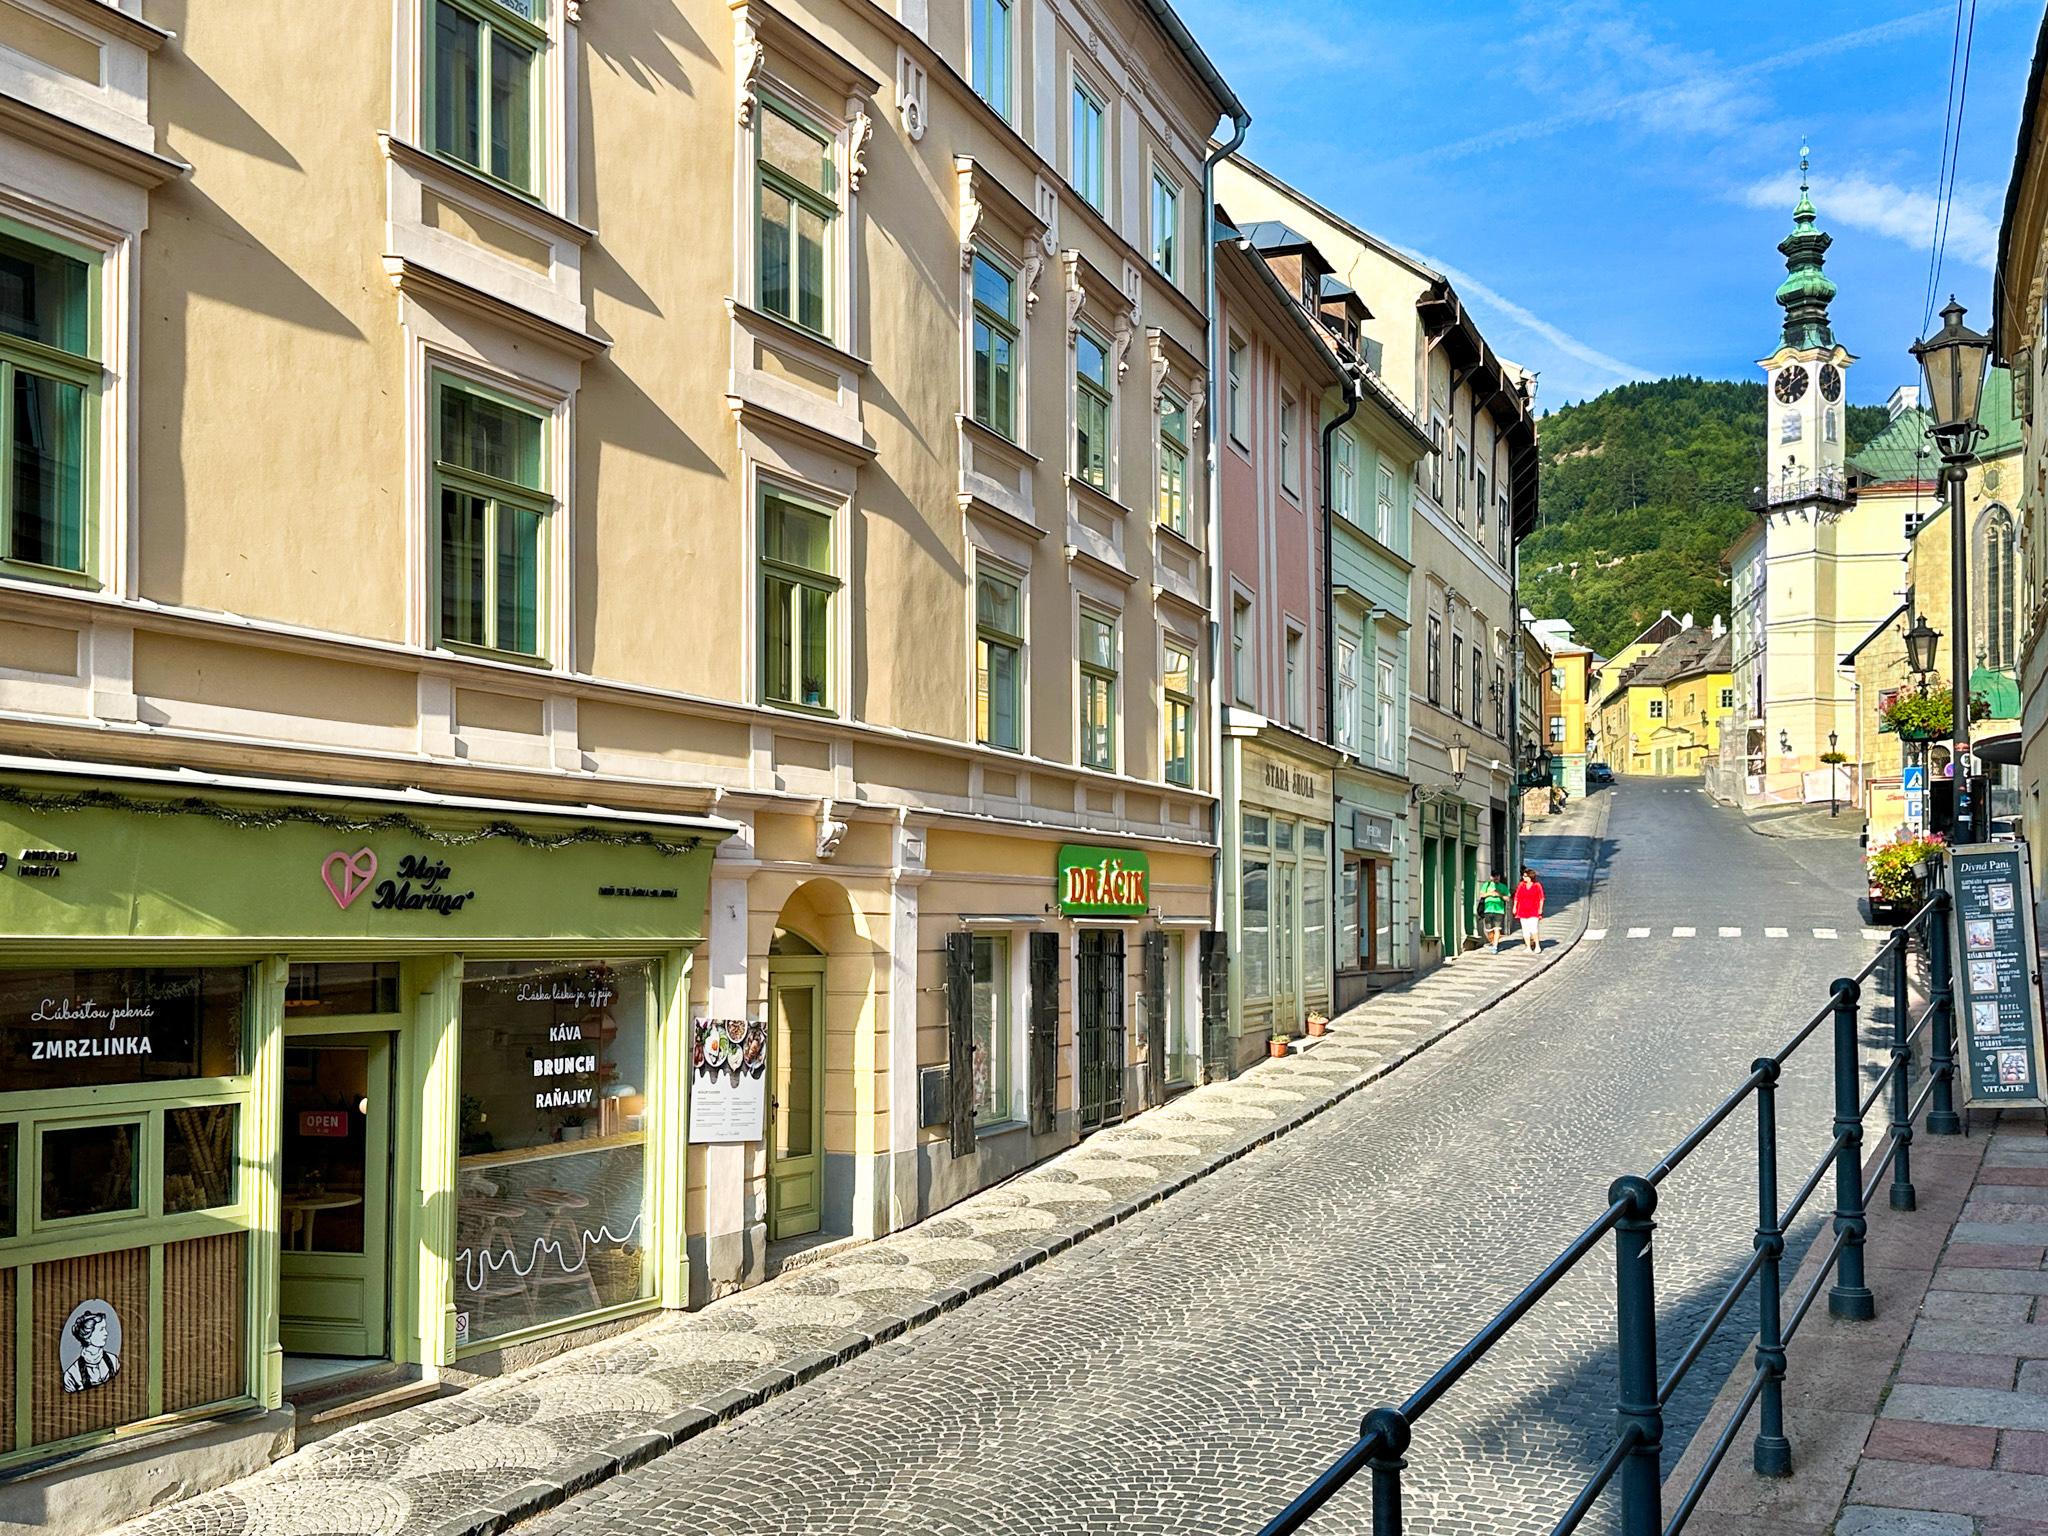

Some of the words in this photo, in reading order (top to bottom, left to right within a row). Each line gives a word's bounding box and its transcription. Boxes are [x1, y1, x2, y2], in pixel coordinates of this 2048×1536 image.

[1266, 763, 1289, 792] STARÁ
[1293, 767, 1314, 799] ŠKOLA
[397, 855, 451, 890] Moja
[1960, 861, 1988, 872] Divná
[1066, 858, 1146, 904] DRÁČIK
[372, 880, 475, 915] Marína
[109, 998, 154, 1030] pekná
[549, 1023, 581, 1042] KÁVA
[32, 1036, 152, 1060] ZMRZLINKA
[533, 1056, 595, 1077] BRUNCH
[536, 1088, 593, 1109] RAŇAJKY
[307, 1116, 339, 1127] OPEN
